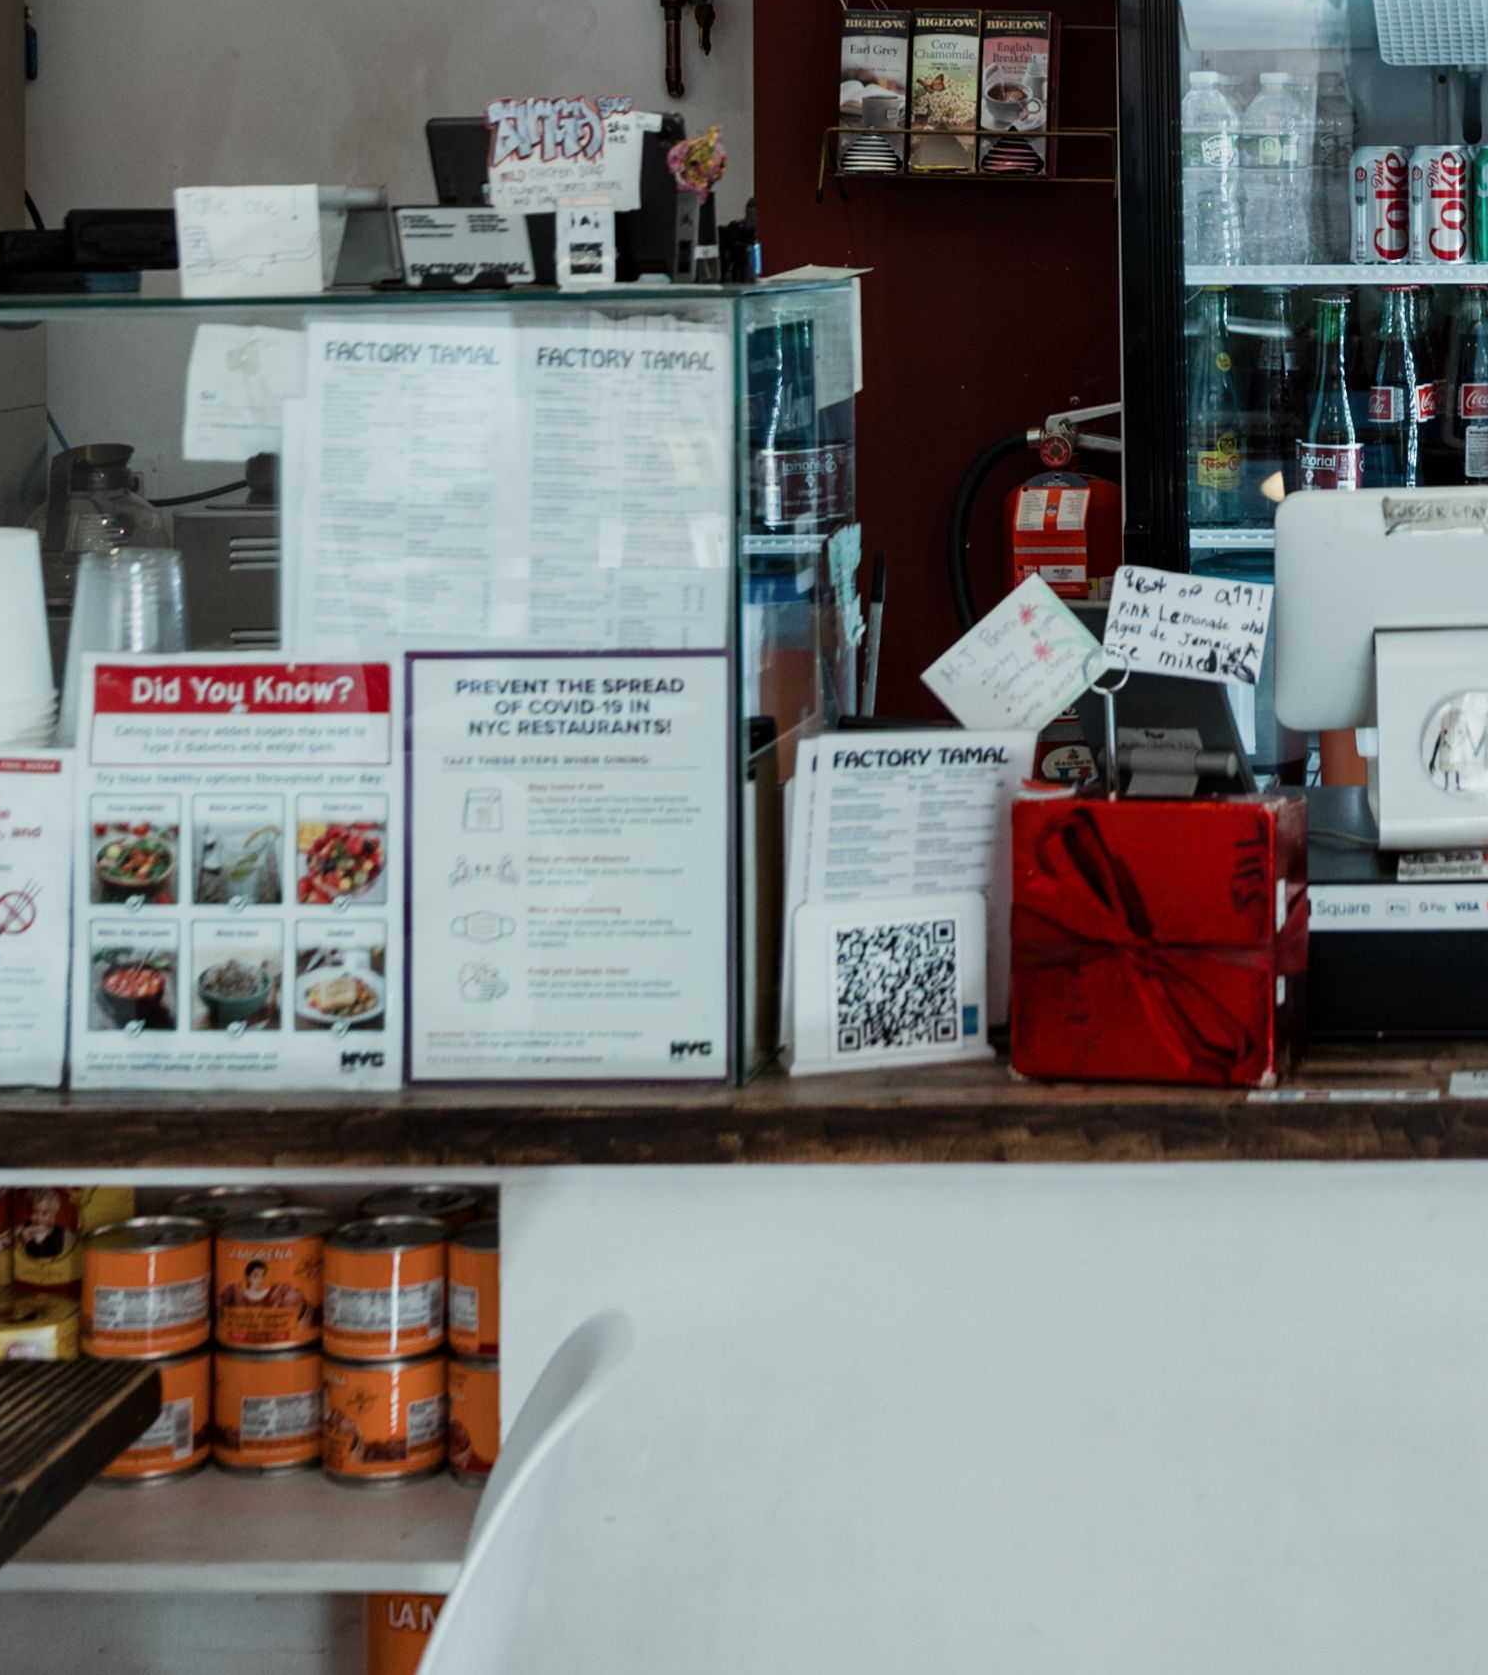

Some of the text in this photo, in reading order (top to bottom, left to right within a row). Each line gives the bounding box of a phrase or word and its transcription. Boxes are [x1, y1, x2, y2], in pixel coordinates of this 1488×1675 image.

[850, 45, 898, 56] Earl Grey
[931, 39, 958, 50] Cozy
[997, 42, 1033, 53] English
[992, 53, 1037, 64] Breakfast
[1374, 151, 1408, 260] Coke
[324, 341, 500, 366] FACTORY TAMAL
[536, 347, 714, 371] FACTORY TAMAL
[131, 675, 353, 703] Did You Know?
[456, 678, 684, 694] PREVENT THE SPREAD
[495, 699, 650, 714] OF COVID-19 IN
[469, 719, 671, 736] NYC RESTAURANTS!
[833, 746, 1009, 768] FACTORY TAMAL
[1317, 898, 1371, 918] Square
[1455, 901, 1479, 912] VISA
